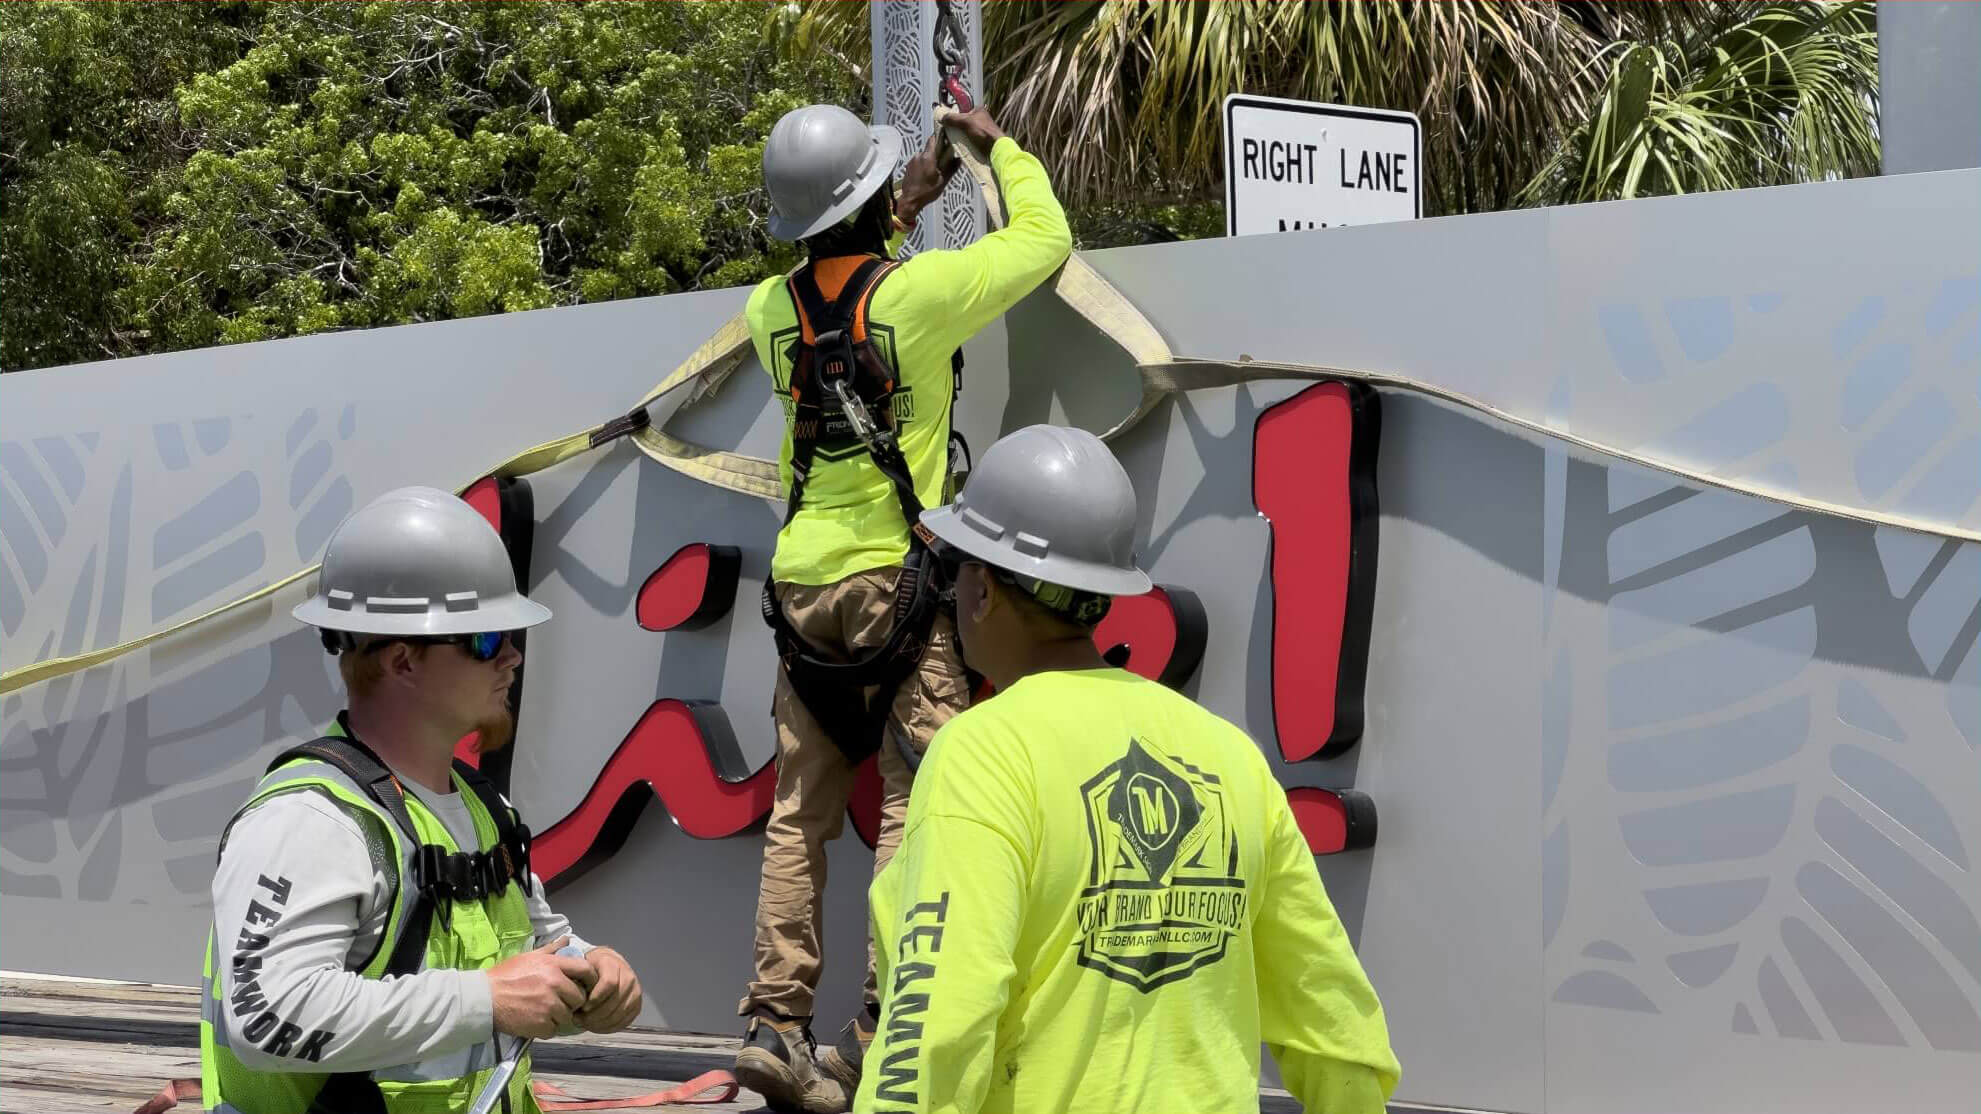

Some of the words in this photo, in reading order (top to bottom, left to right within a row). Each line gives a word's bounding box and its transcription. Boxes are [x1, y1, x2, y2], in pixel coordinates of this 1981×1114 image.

[1243, 138, 1317, 184] RIGHT
[1341, 148, 1408, 193] LANE
[231, 873, 336, 1063] TEAMWORK
[1198, 891, 1246, 930] FOCUS!
[874, 891, 949, 1114] TEAMW
